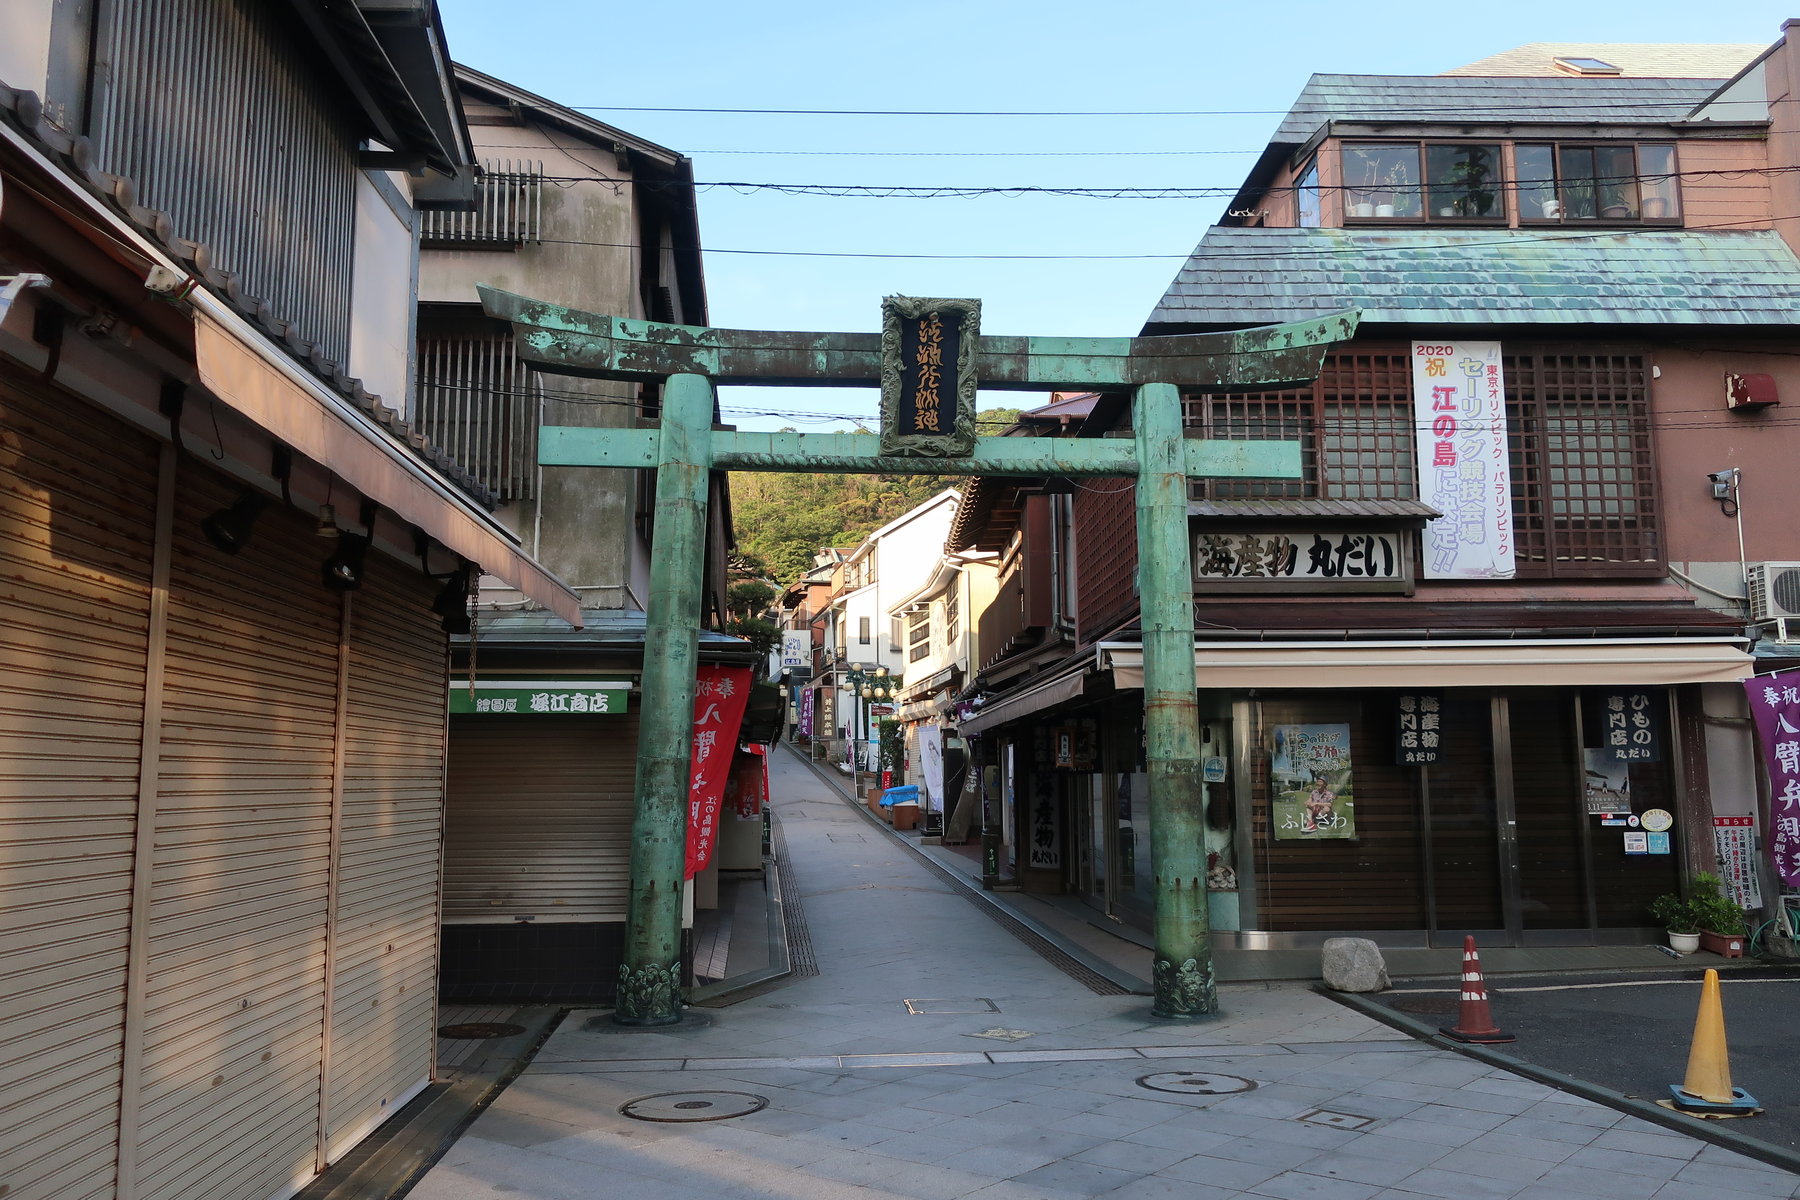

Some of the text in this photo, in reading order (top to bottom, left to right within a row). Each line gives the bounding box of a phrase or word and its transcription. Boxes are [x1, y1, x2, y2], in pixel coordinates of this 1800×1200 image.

[1416, 345, 1454, 356] 2020
[1425, 357, 1447, 377] 祝
[1459, 357, 1487, 545] セーリング競技会場
[1486, 364, 1509, 556] 東京オリンピック・パラリンピック
[1199, 533, 1394, 578] 海産物 丸だい
[530, 693, 609, 712] 堀江商店
[1763, 685, 1800, 707] 奉祝
[1420, 696, 1440, 748] 海産物
[1607, 695, 1628, 746] 専門店
[1629, 694, 1652, 745] ひもの
[1405, 751, 1436, 762] 丸だい
[1615, 747, 1651, 759] 丸だい
